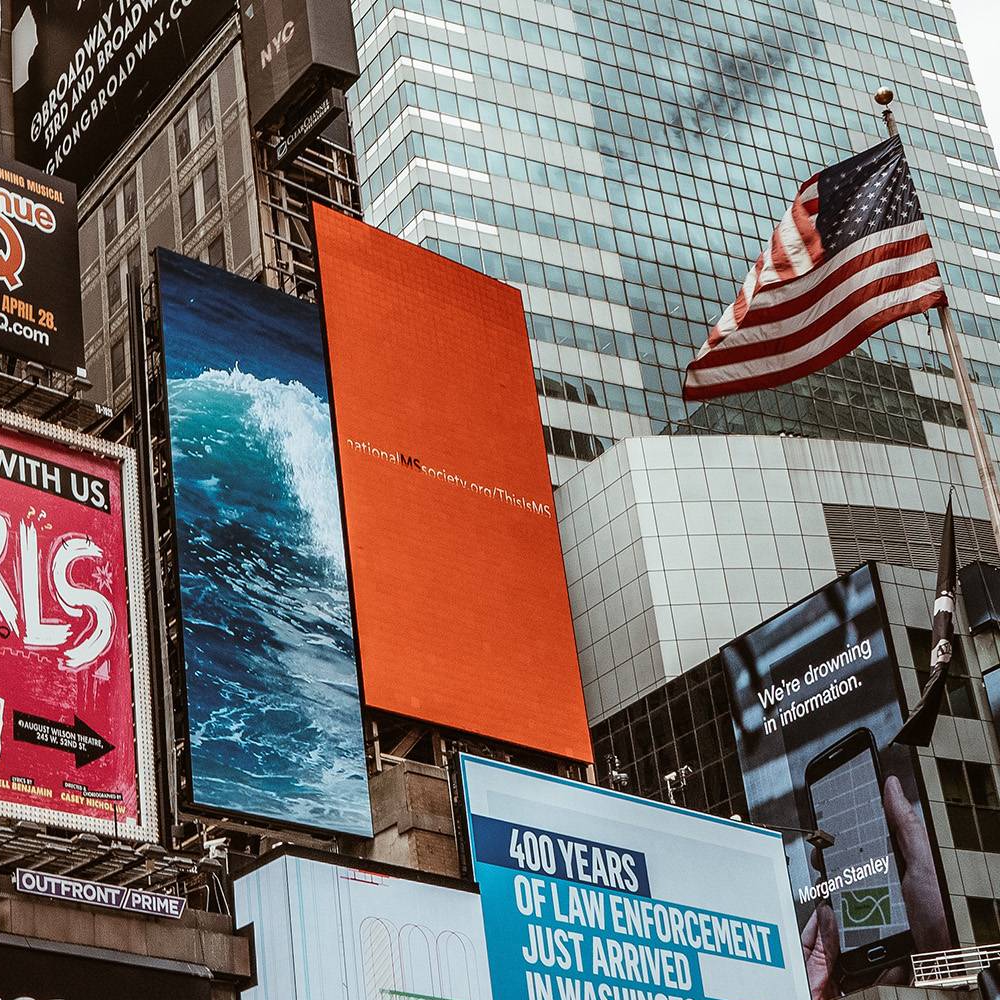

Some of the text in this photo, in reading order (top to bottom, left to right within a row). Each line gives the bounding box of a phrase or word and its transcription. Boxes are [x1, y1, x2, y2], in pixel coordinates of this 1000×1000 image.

[260, 21, 294, 69] NYC
[44, 102, 69, 149] 53RD
[71, 66, 94, 111] AND
[97, 0, 158, 73] BROADW
[27, 179, 64, 204] MUSICAL
[2, 295, 35, 323] APRIL
[38, 309, 57, 331] 28.
[70, 473, 108, 510] US.
[757, 637, 873, 710] We're drowning
[763, 672, 863, 735] in information.
[36, 732, 87, 752] 245 W. 52ND ST.
[51, 727, 76, 741] WILSON
[11, 781, 53, 798] BENJAMIN
[61, 792, 126, 813] CASEY NICHOLW
[509, 829, 639, 892] 400 YEARS
[798, 855, 890, 904] Morgan Stanley
[22, 873, 179, 916] OUTFRONT PRIME
[514, 874, 772, 962] OF LAW ENFORCEMENT
[522, 924, 692, 991] JUST ARRIVED
